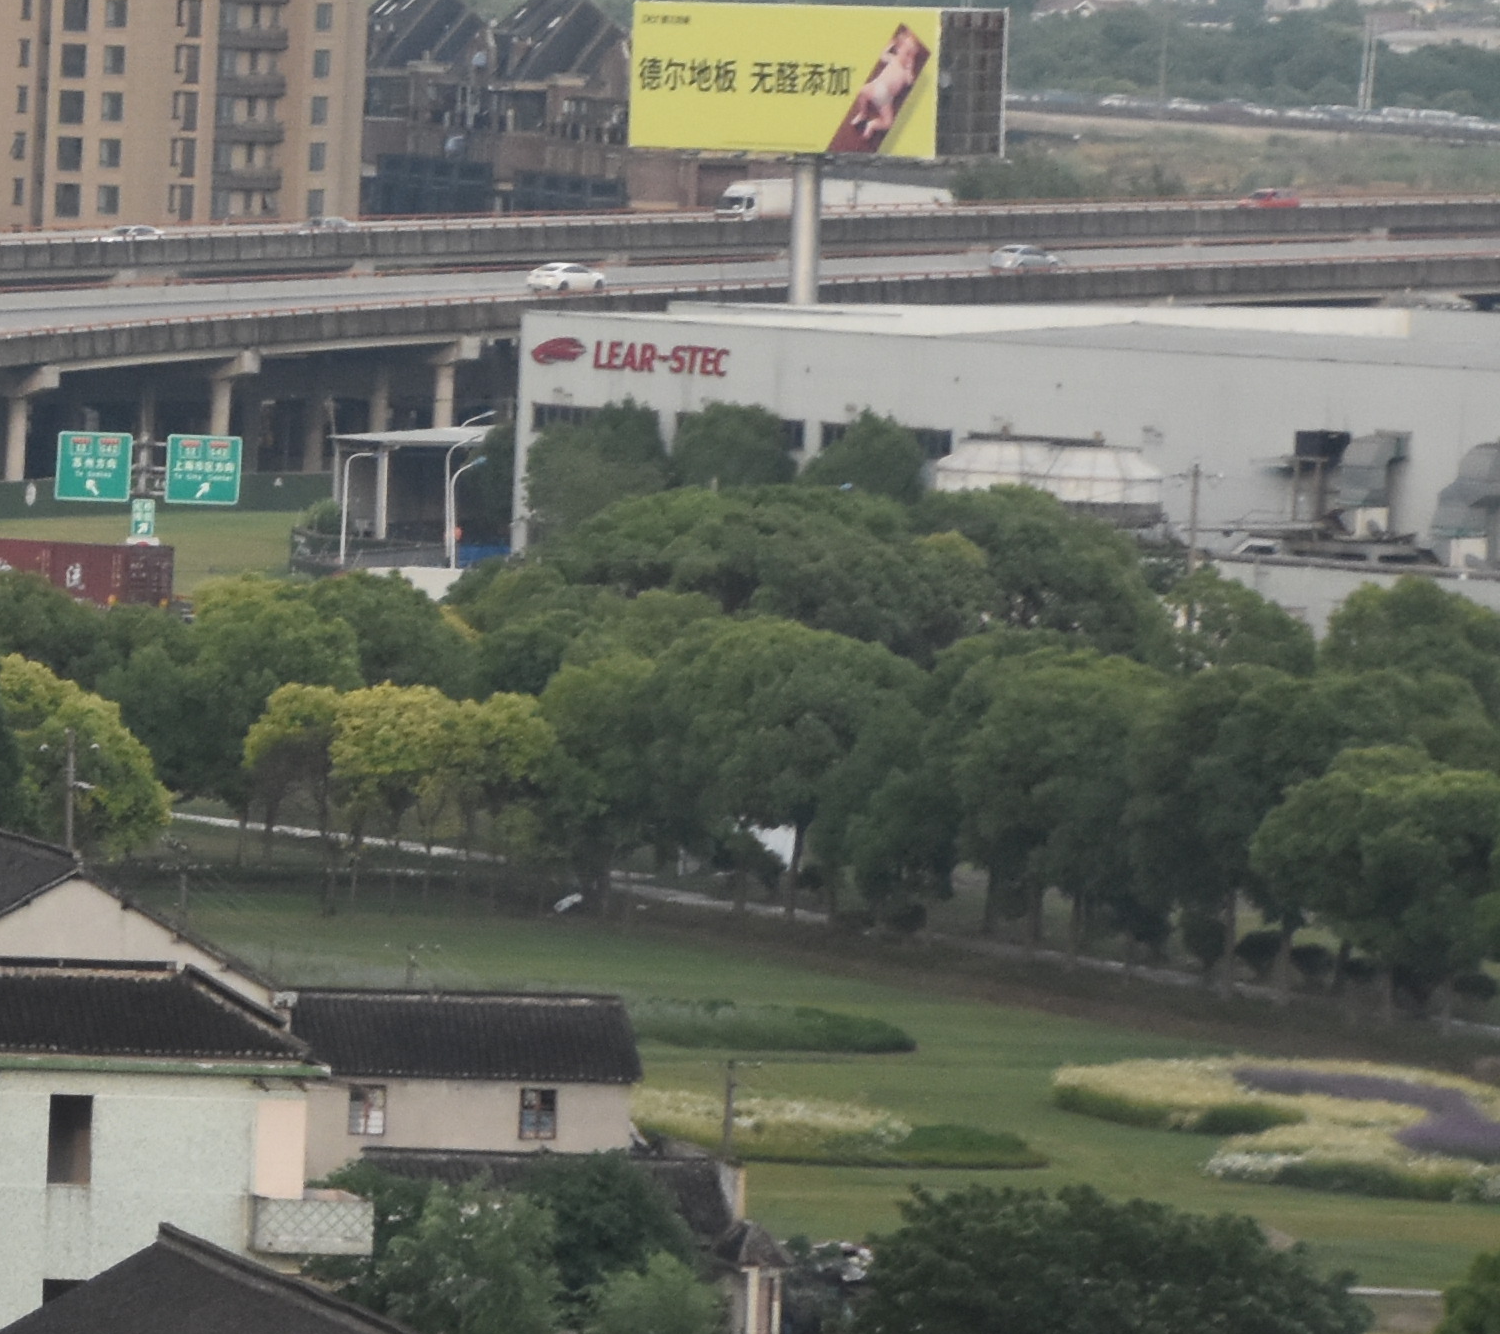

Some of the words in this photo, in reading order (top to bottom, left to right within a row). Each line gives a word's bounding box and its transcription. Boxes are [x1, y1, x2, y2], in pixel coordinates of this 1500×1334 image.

[639, 57, 736, 93] 德尔地板
[750, 61, 852, 96] 无醛添加
[593, 340, 730, 377] LEAR-STEC
